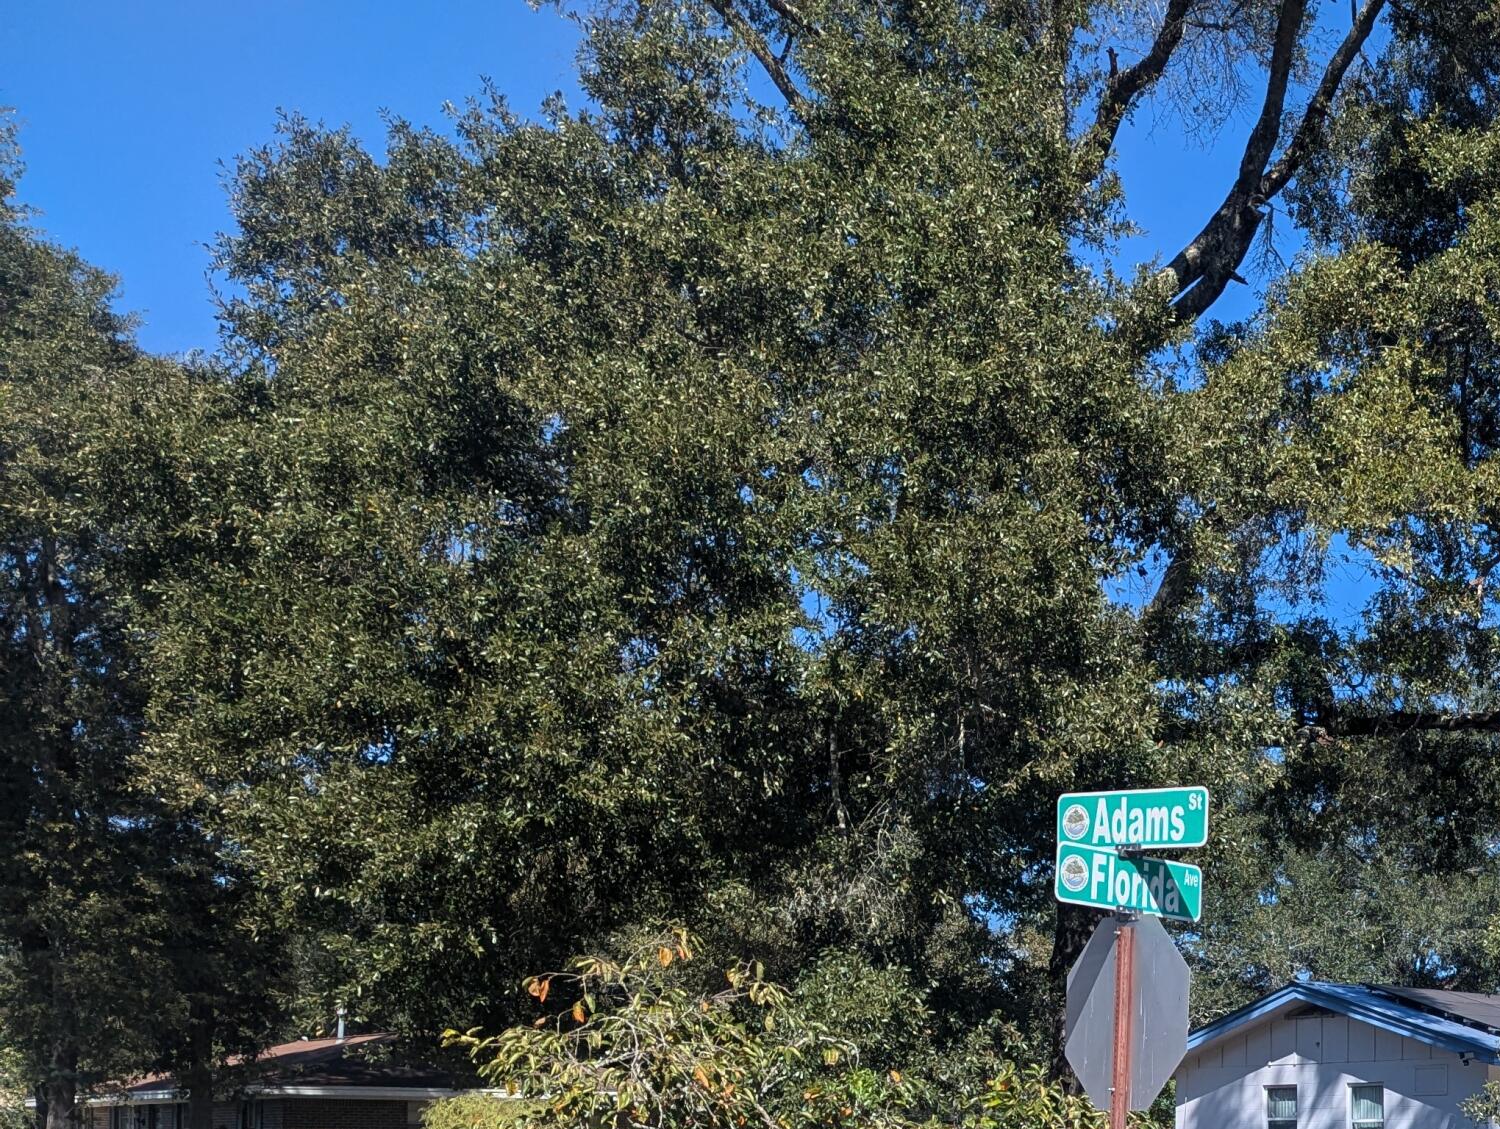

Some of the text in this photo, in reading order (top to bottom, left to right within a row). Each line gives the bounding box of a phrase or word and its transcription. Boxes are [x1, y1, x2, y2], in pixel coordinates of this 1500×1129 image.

[1092, 796, 1185, 844] Adams
[1188, 792, 1202, 811] St
[1090, 853, 1180, 913] Florida
[1183, 869, 1199, 887] Ave
